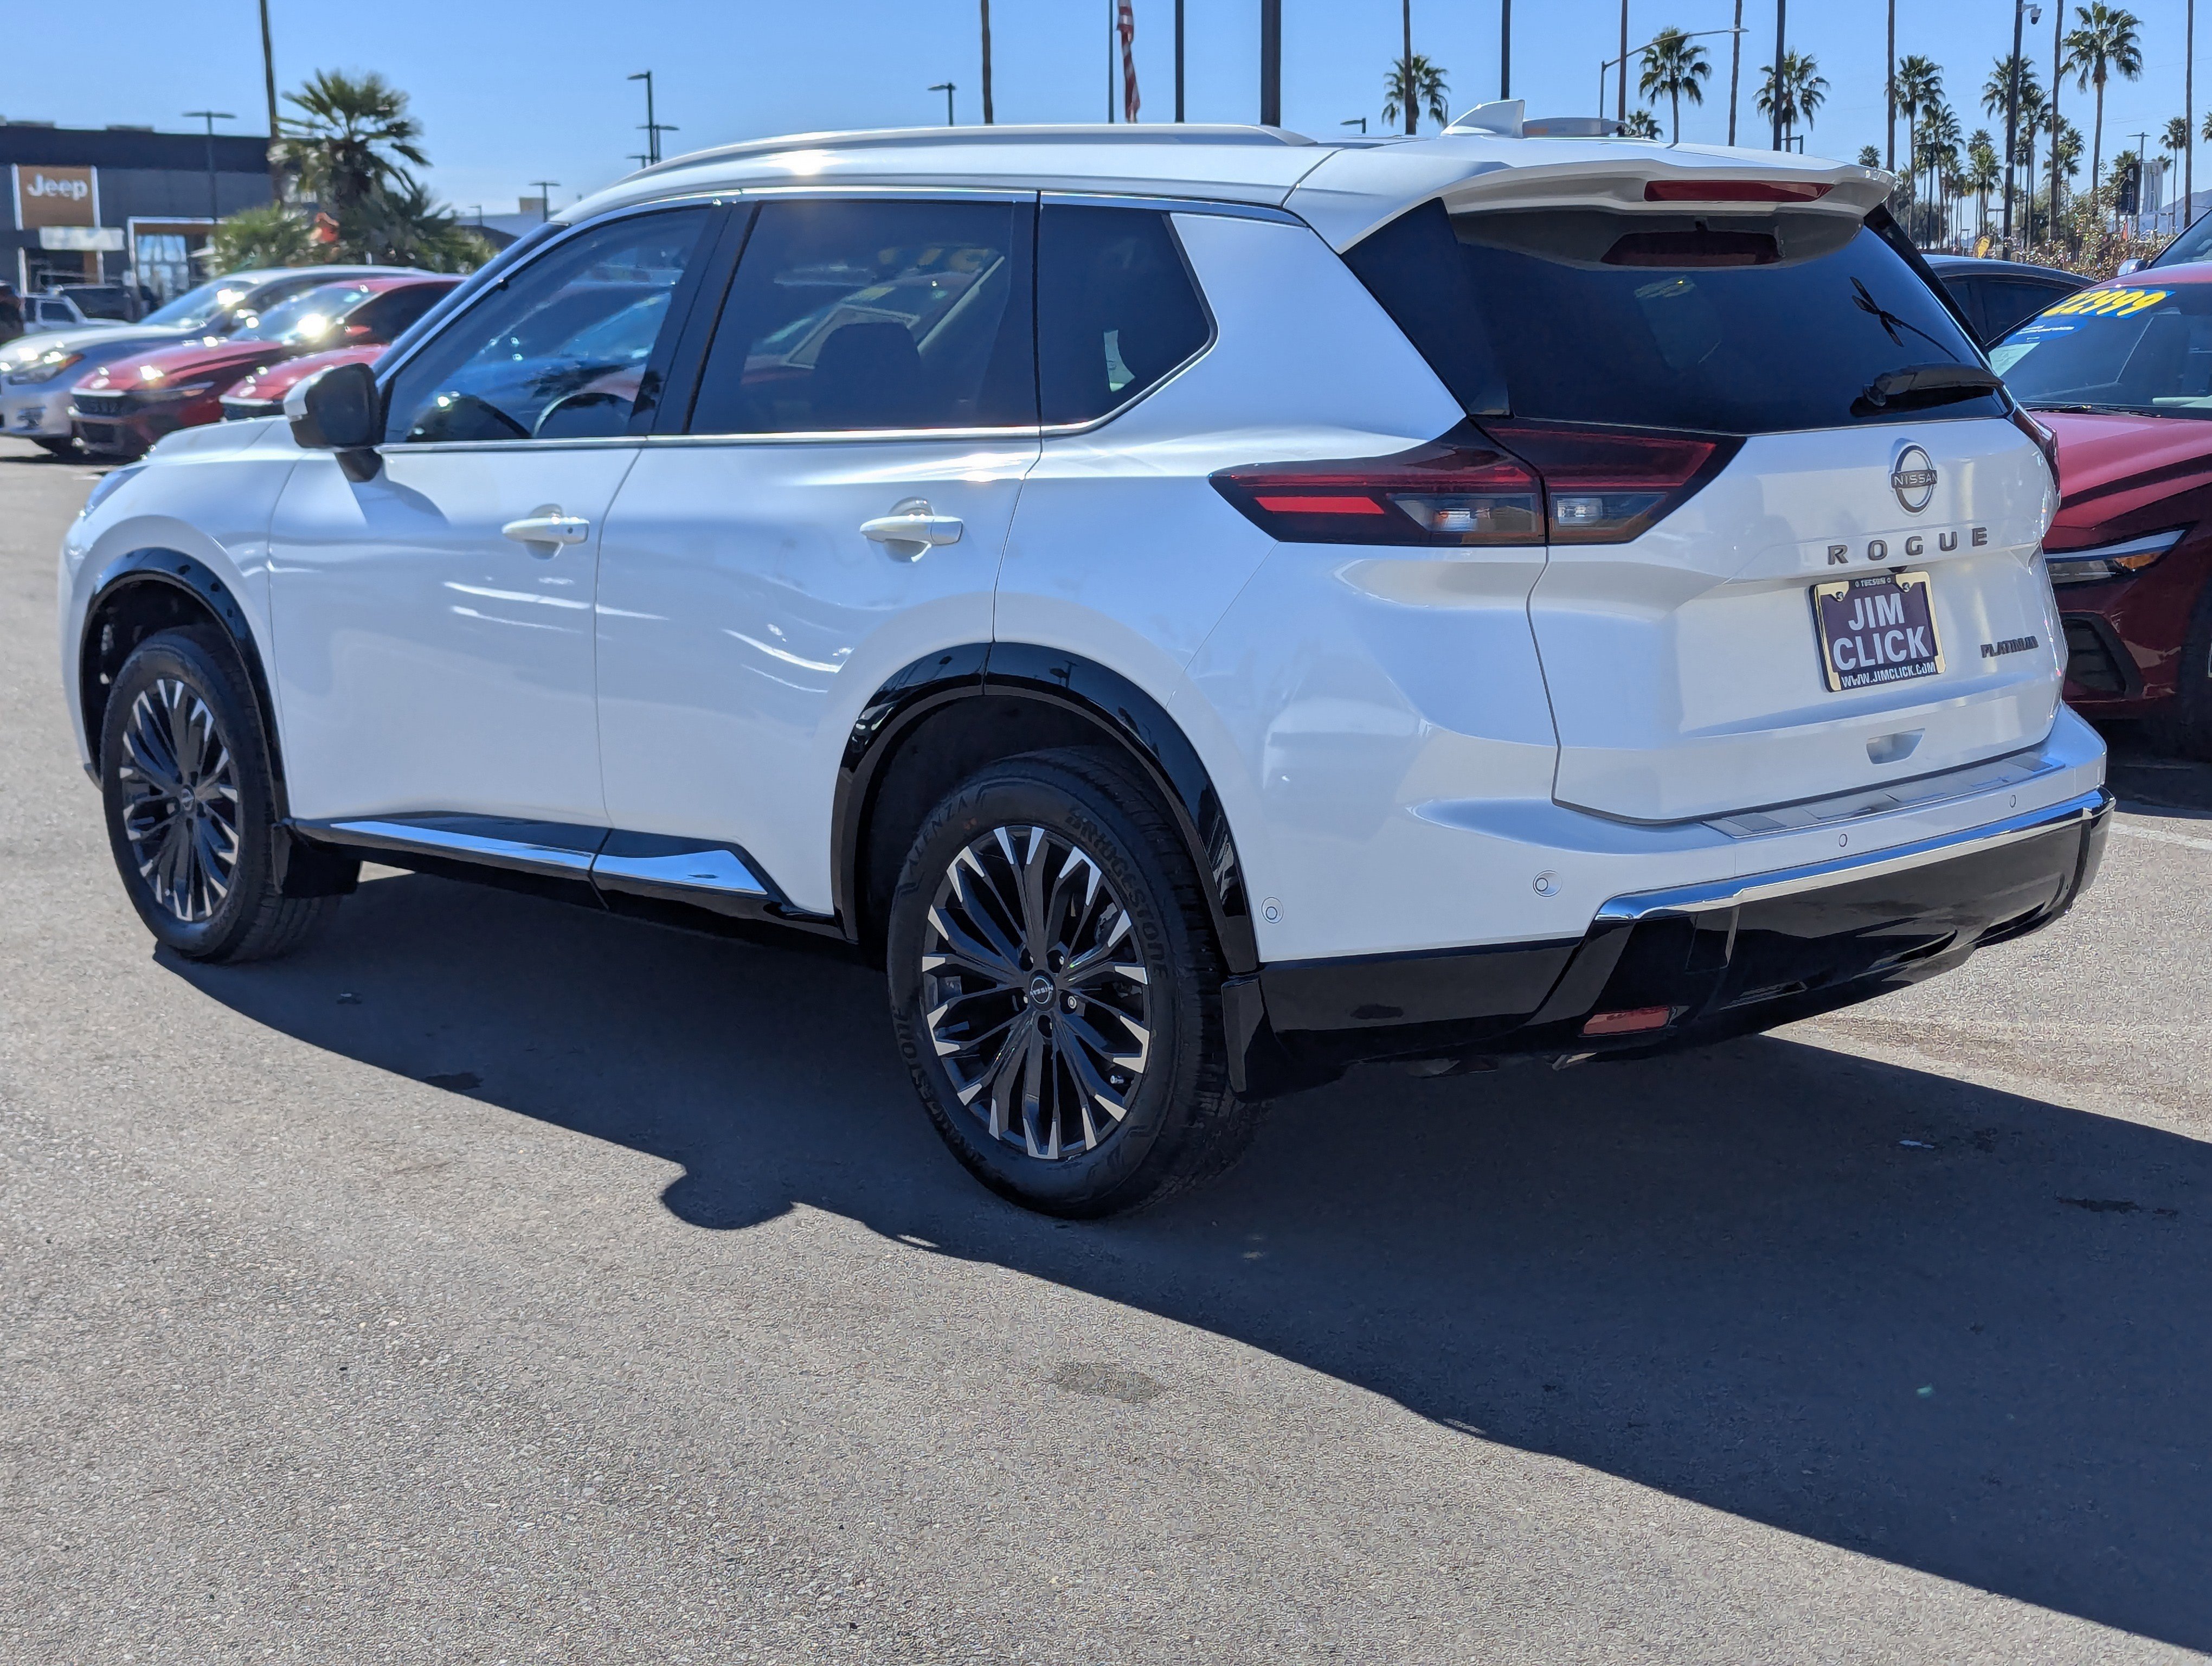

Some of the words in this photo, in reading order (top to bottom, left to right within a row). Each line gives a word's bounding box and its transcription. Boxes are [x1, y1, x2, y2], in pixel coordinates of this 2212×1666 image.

[28, 174, 88, 201] Jeep
[1894, 471, 1938, 486] NISSAN
[1828, 527, 1988, 565] ROGUE
[1848, 593, 1905, 631] JIM
[1833, 626, 1930, 670] CLICK
[1980, 636, 2039, 658] PLATINUM
[1841, 662, 1936, 688] WWW.JIMCLICK.COM
